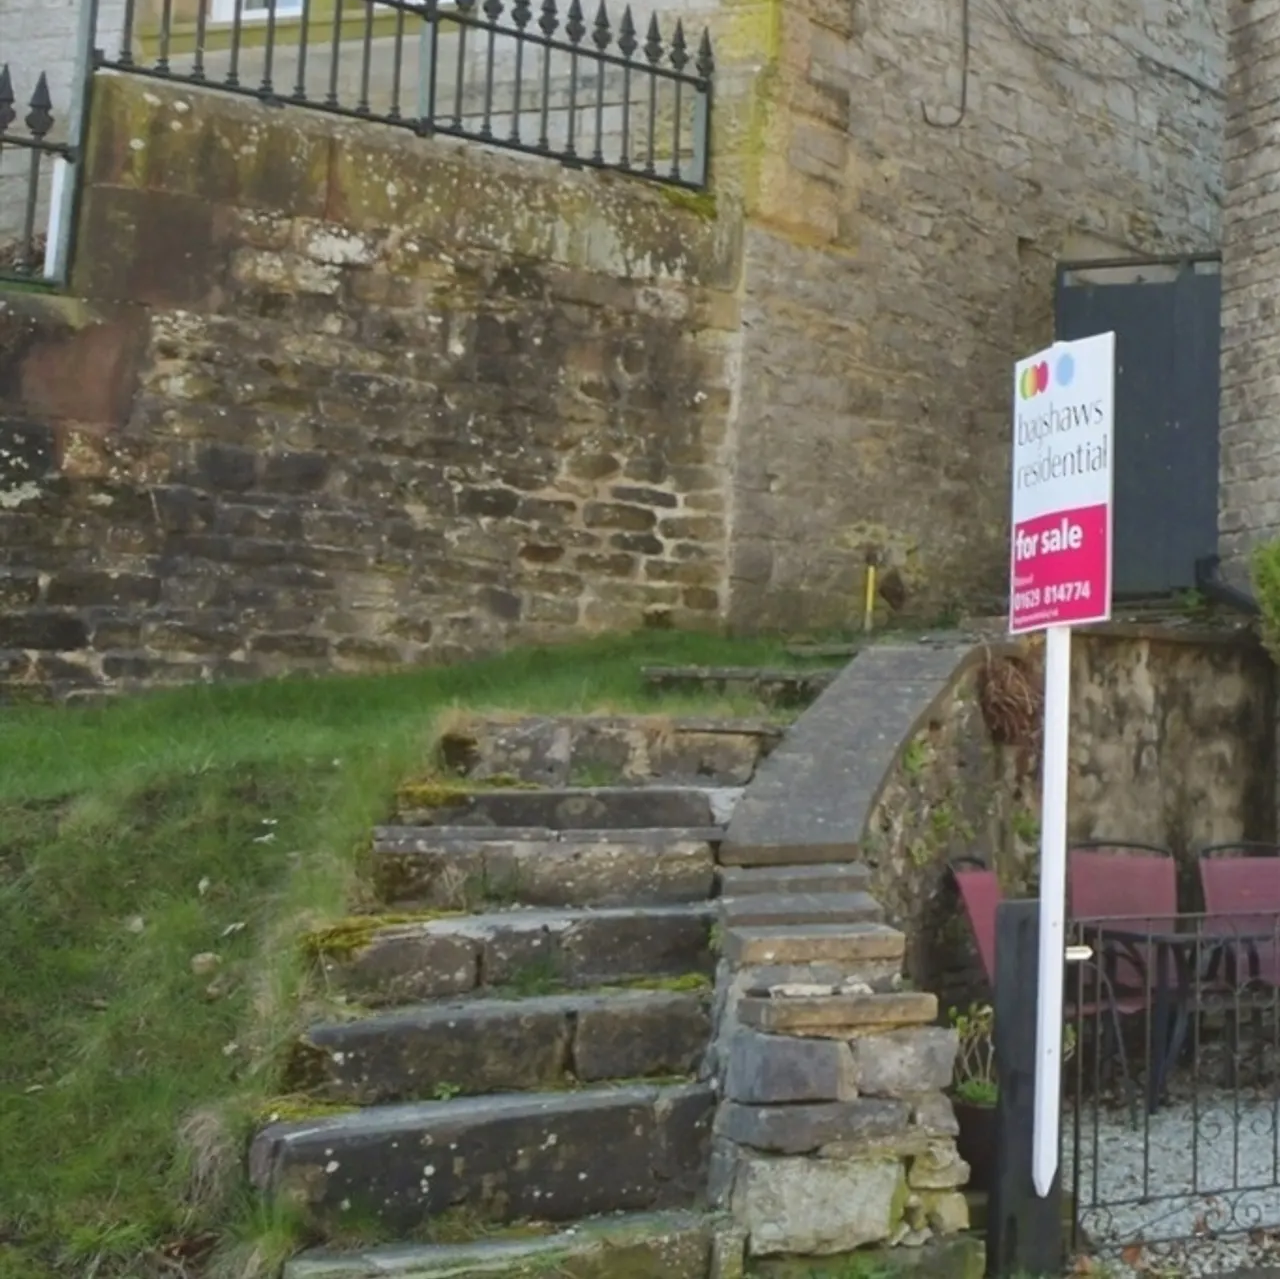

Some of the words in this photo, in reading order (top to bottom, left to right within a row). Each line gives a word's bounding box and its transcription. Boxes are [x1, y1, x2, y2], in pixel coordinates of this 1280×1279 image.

[1017, 400, 1103, 449] bagshaws
[1017, 433, 1107, 490] residential
[1015, 529, 1039, 561] for
[1041, 517, 1083, 554] sale
[1044, 580, 1091, 605] 814774
